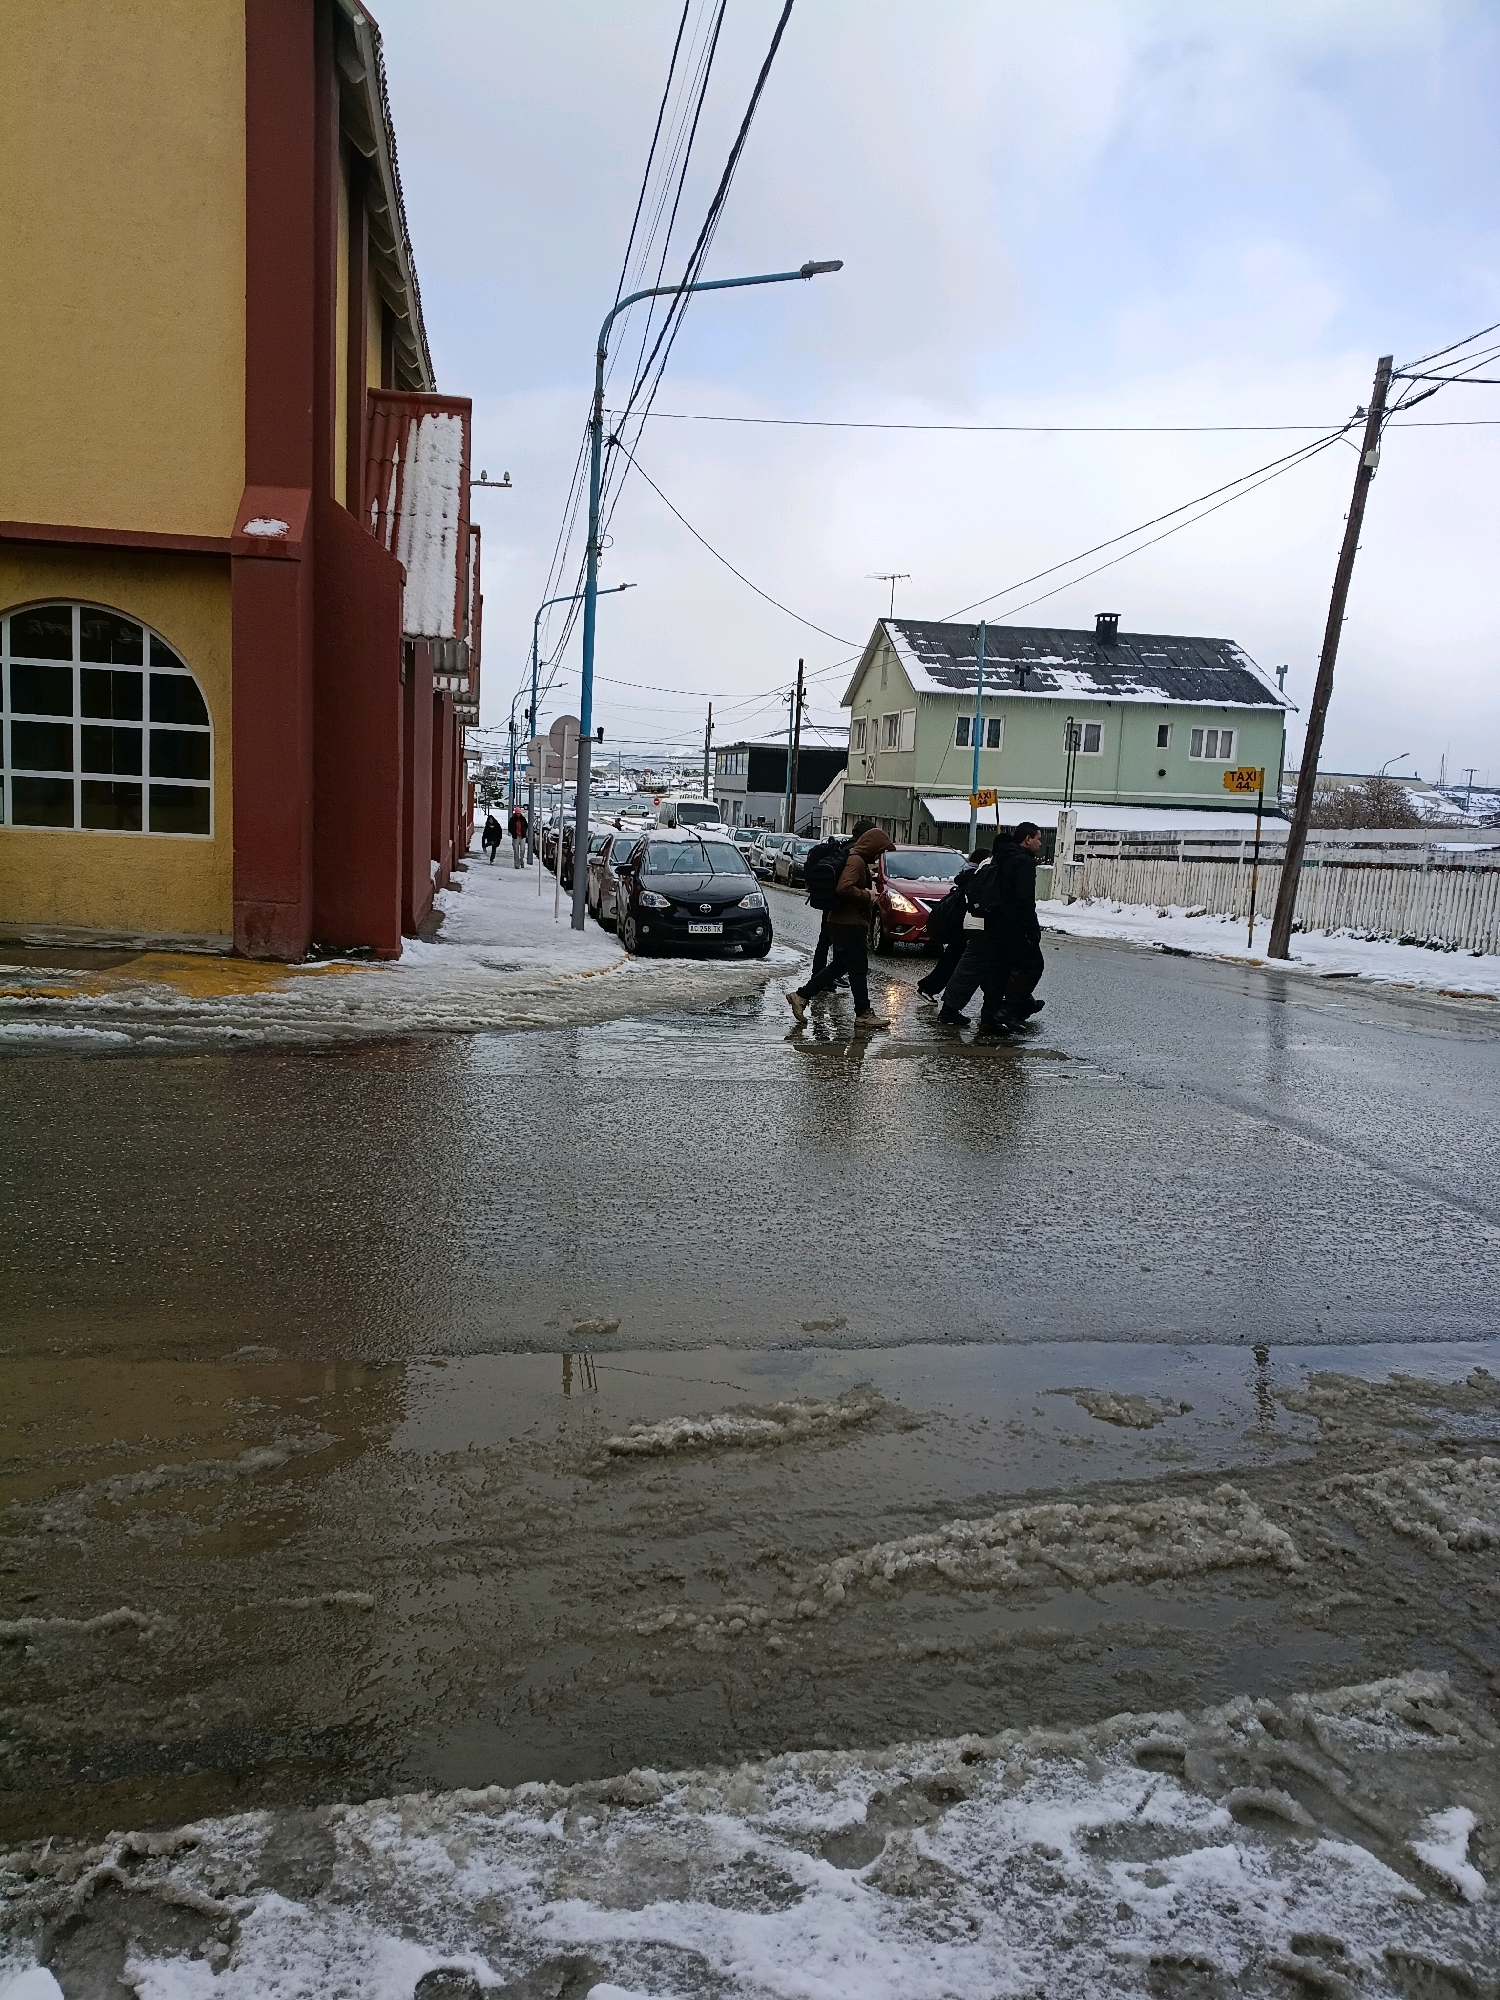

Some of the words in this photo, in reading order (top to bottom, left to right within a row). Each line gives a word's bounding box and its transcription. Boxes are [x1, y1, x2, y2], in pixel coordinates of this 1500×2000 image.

[1230, 771, 1257, 782] TAXI
[1235, 781, 1251, 791] 44
[972, 791, 992, 801] TAXI
